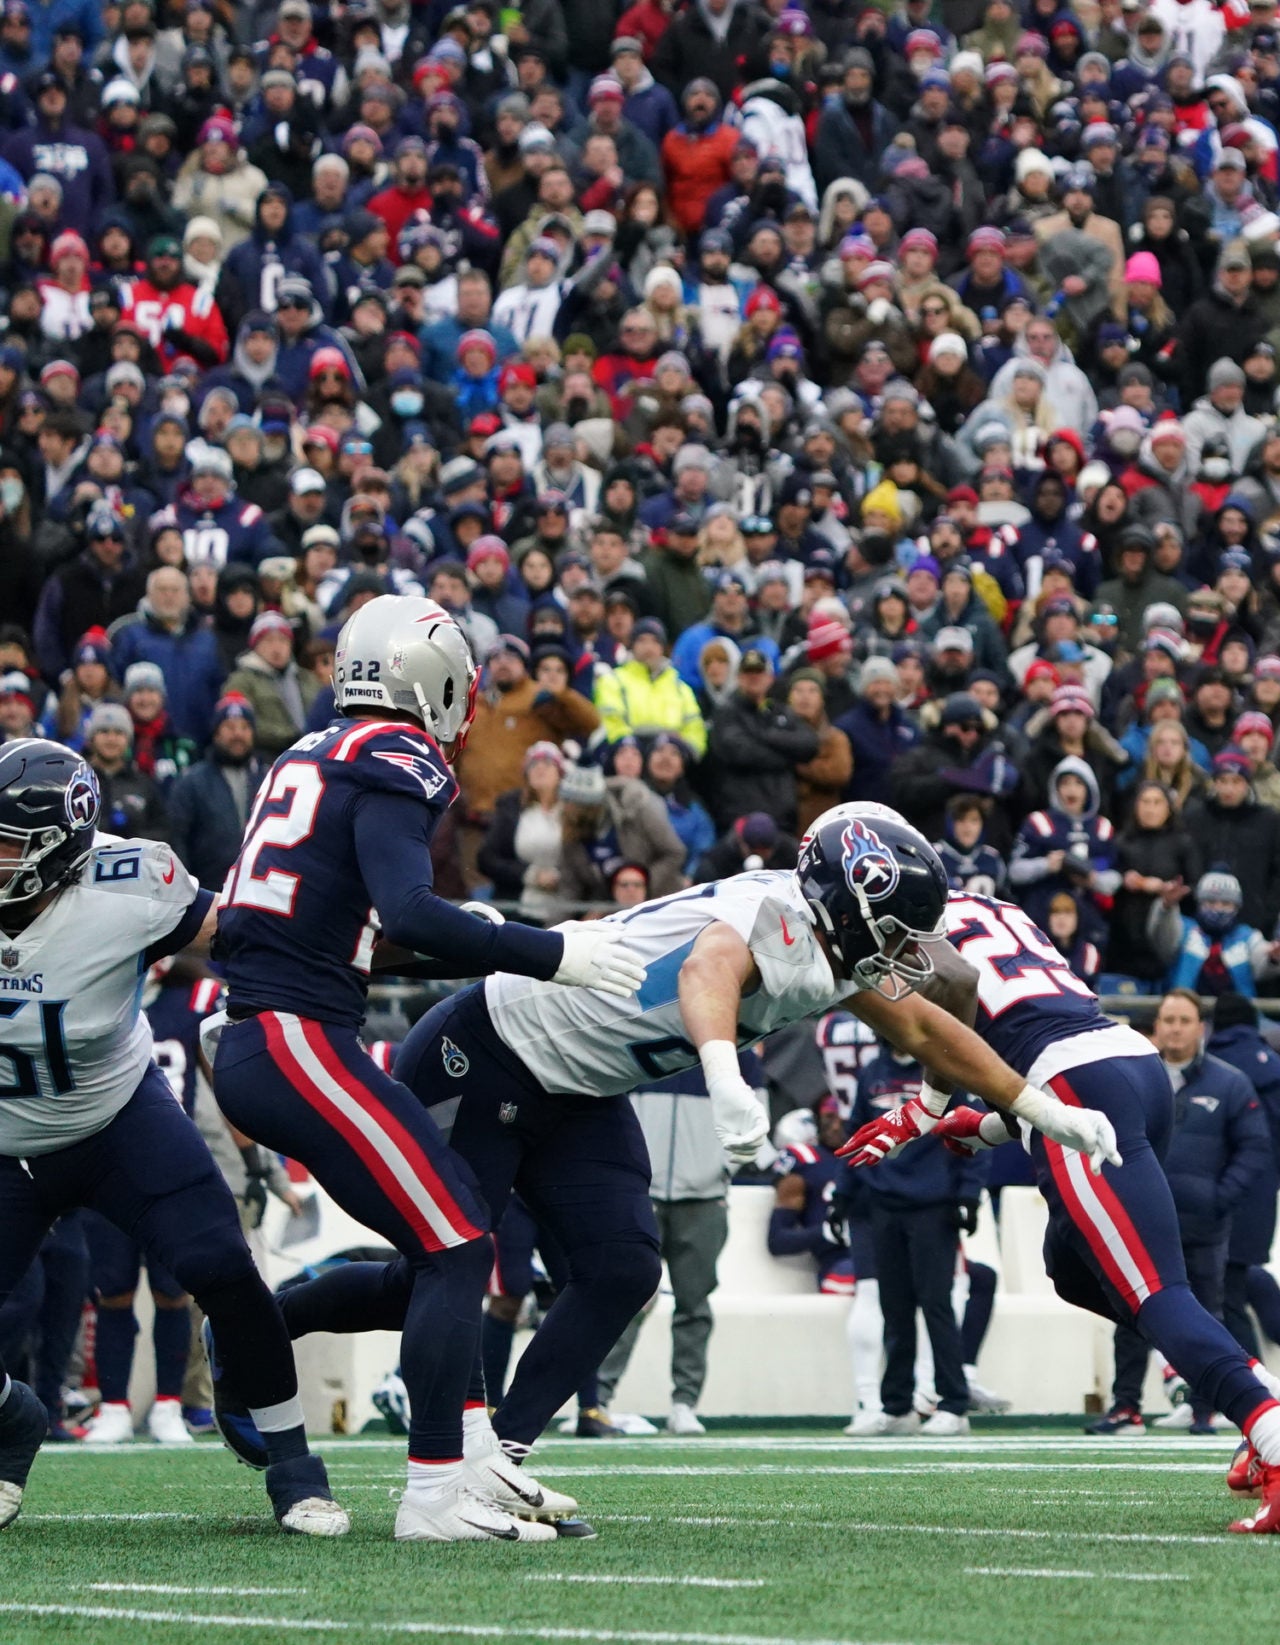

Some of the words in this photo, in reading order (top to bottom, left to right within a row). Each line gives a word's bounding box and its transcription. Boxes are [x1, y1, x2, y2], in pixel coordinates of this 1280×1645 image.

[352, 660, 381, 682] 22
[344, 687, 383, 701] PATRIOTS
[218, 758, 328, 919] 2
[93, 847, 144, 884] 61
